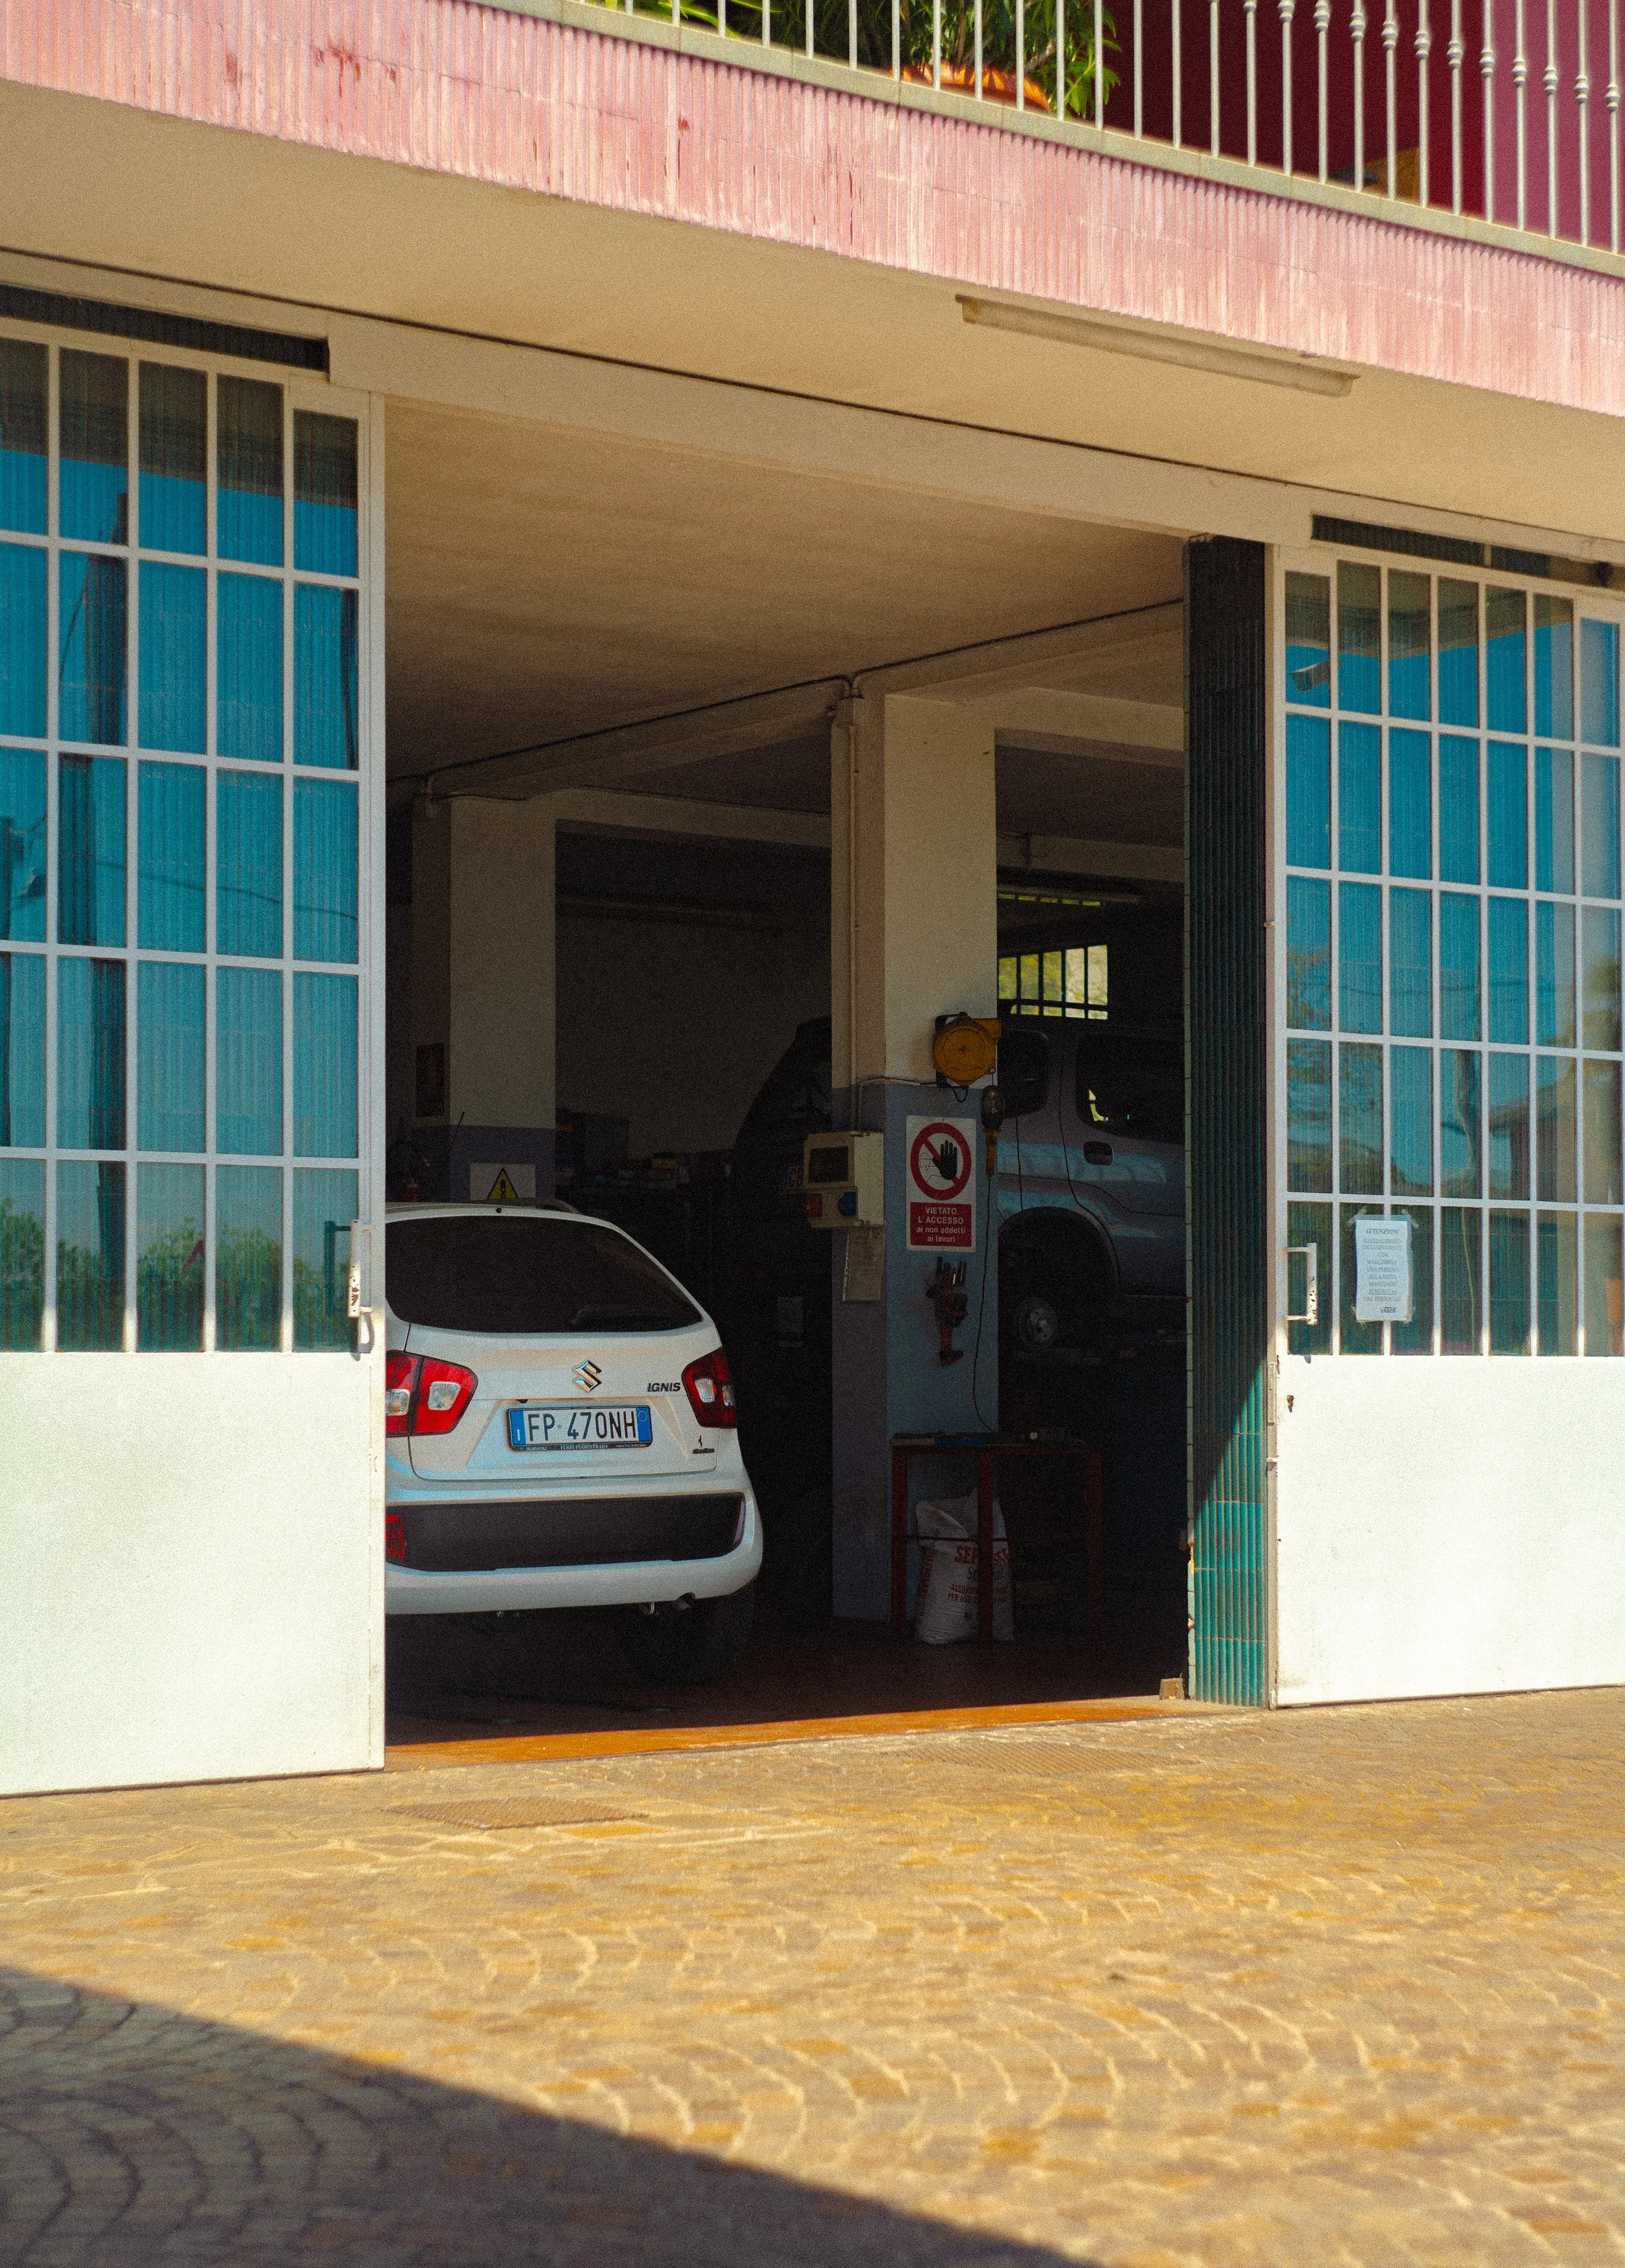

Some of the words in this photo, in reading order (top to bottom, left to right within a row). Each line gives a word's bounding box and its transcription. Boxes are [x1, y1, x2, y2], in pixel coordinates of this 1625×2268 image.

[647, 1382, 681, 1392] IGNIS
[527, 1413, 556, 1441] FP
[567, 1410, 637, 1440] 470NH
